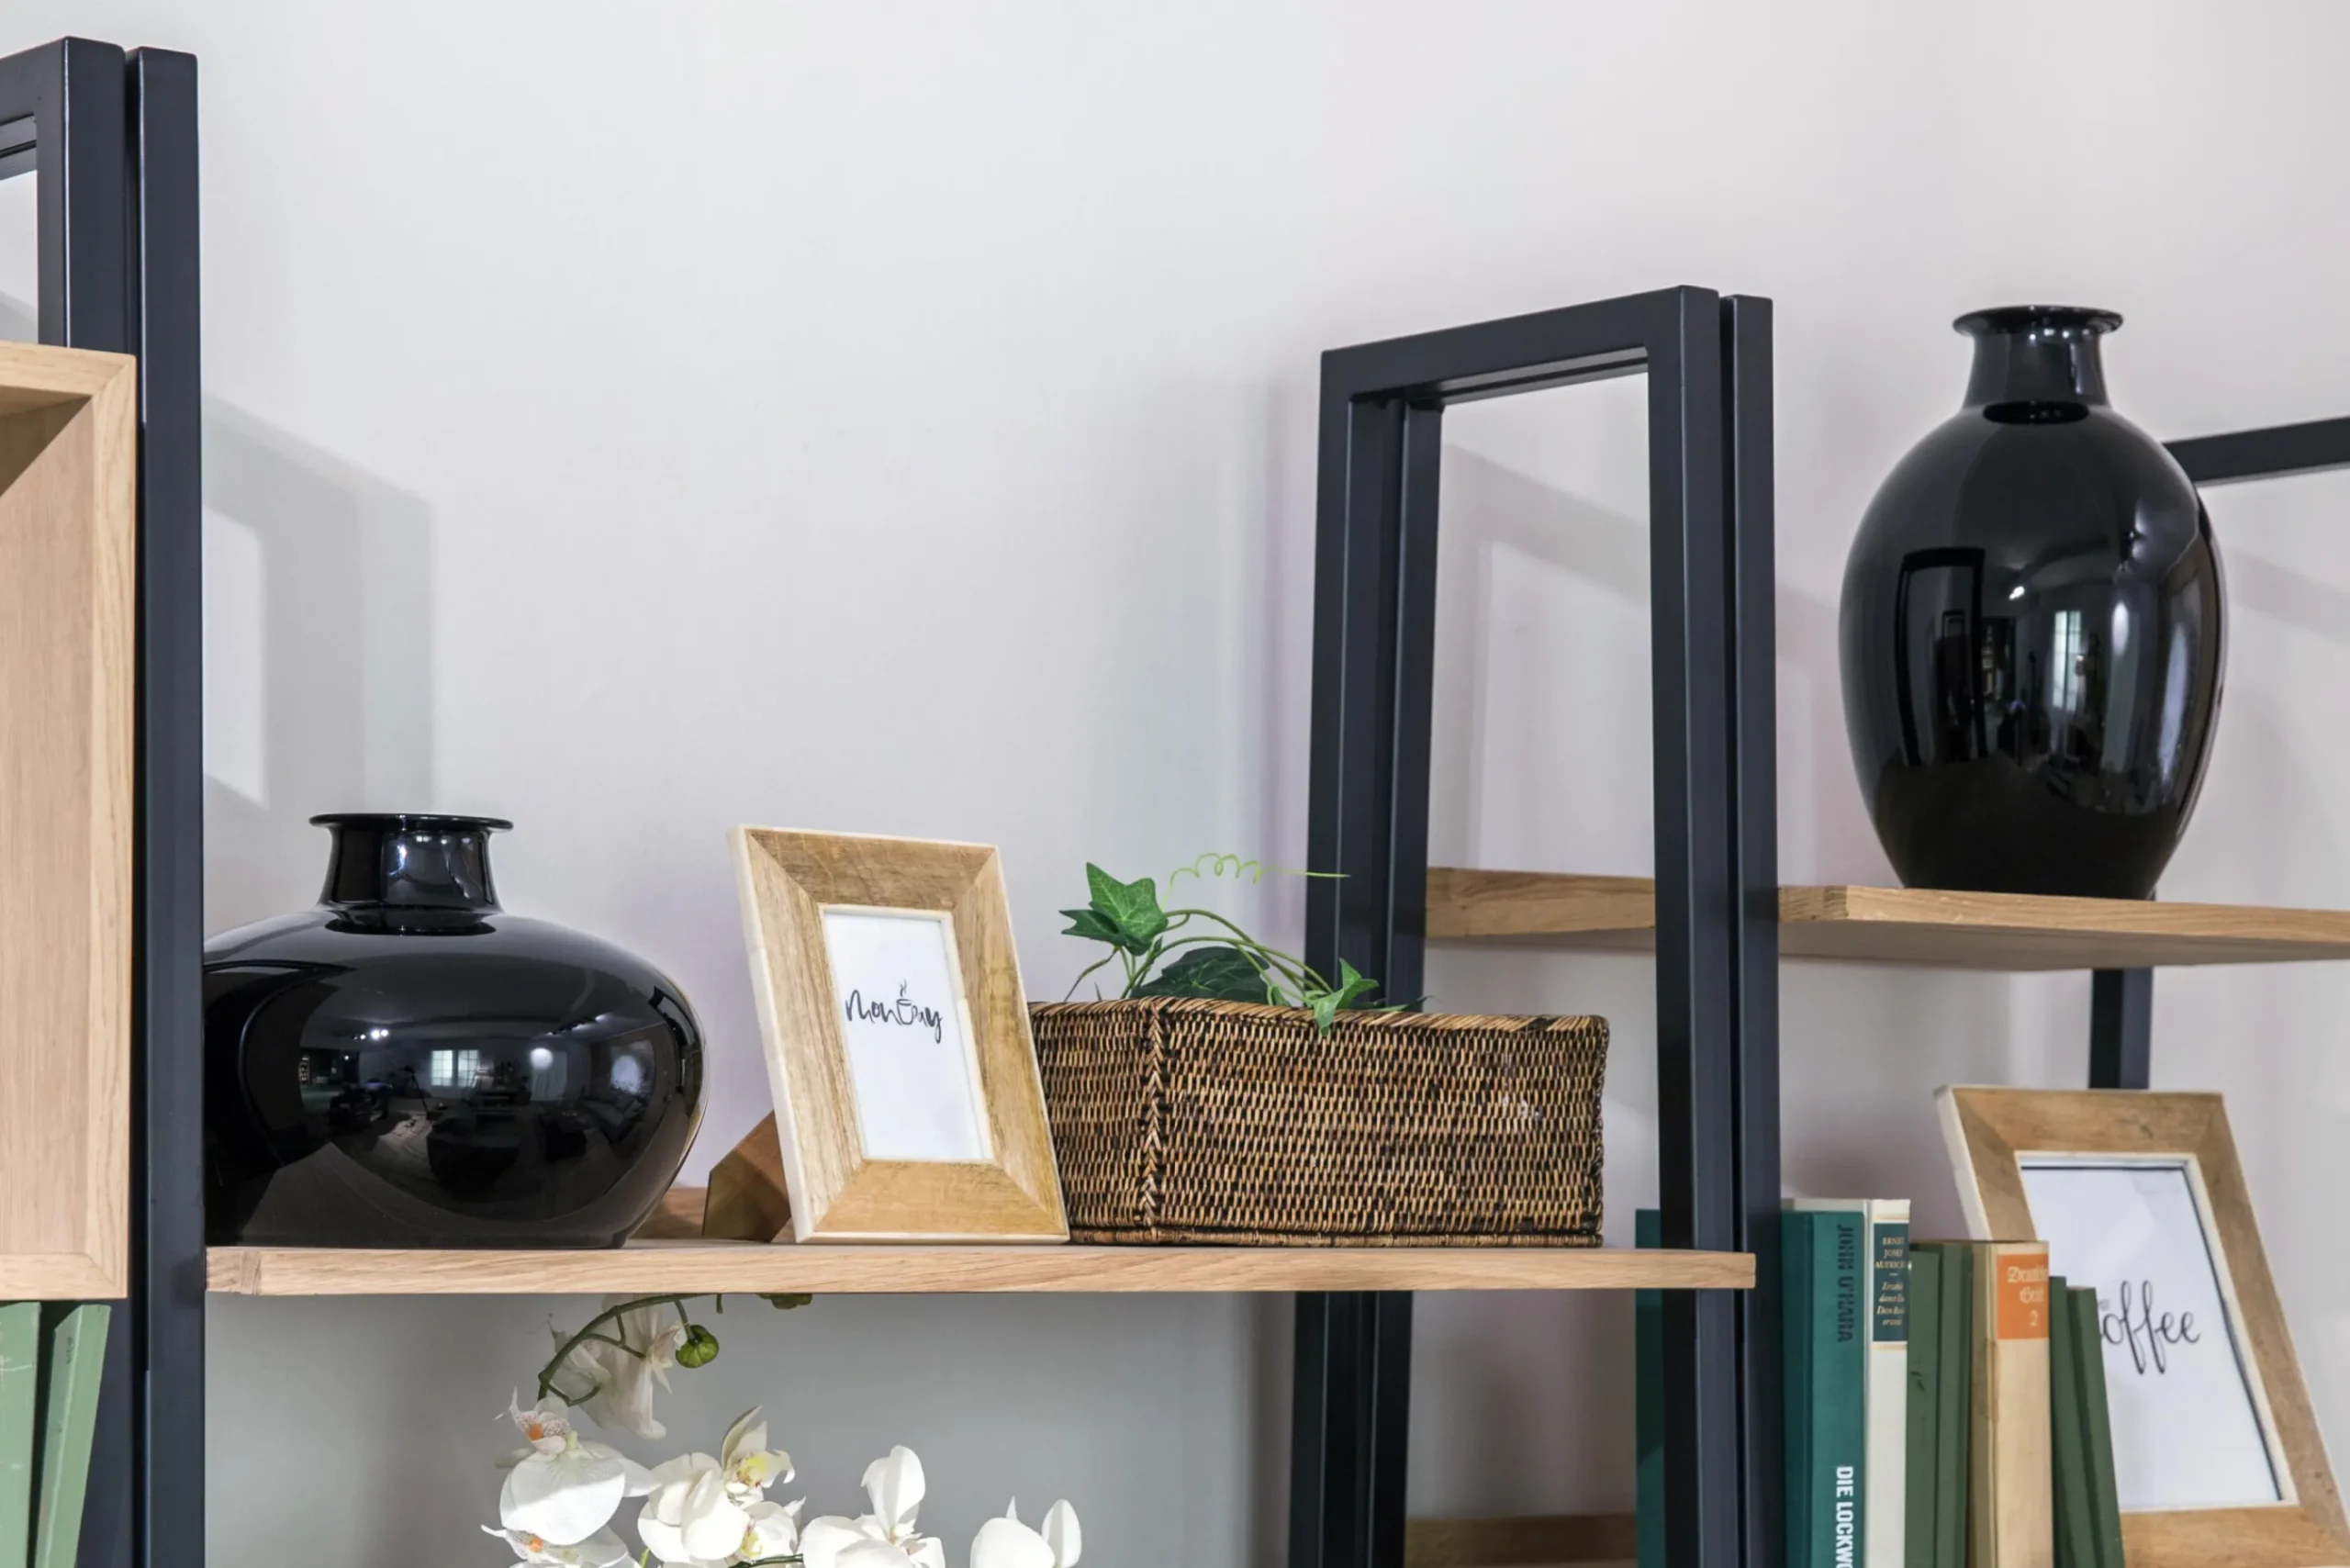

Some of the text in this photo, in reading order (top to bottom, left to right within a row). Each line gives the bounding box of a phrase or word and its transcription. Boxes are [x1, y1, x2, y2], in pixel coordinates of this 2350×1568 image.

[1837, 1223, 1854, 1343] JOHN O'HARA
[2029, 1309, 2039, 1327] 2
[2101, 1279, 2201, 1375] offee
[1836, 1466, 1854, 1498] DIE
